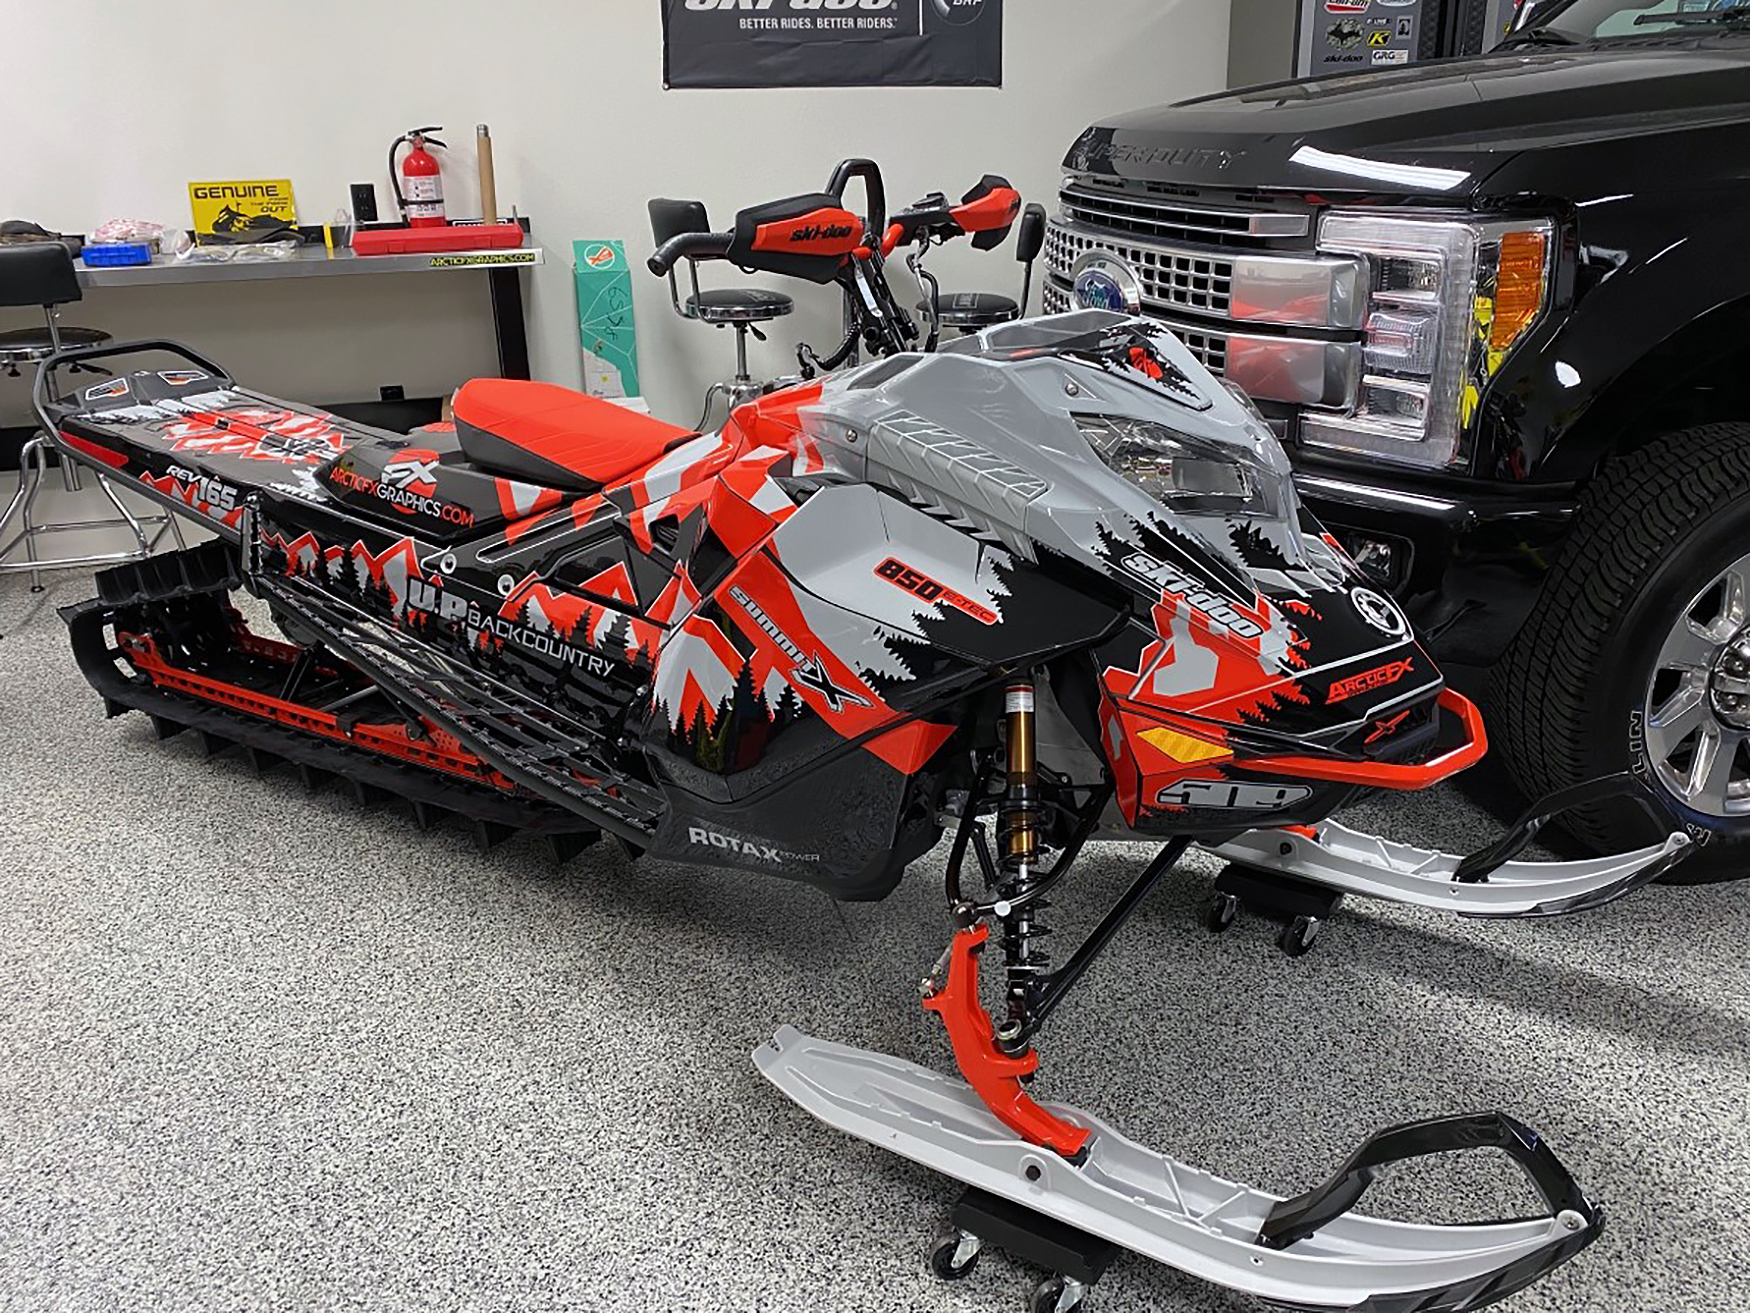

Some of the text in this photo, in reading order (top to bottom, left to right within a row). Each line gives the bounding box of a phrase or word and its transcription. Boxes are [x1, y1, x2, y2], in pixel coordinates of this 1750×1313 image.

[739, 17, 779, 29] BETTER
[781, 17, 814, 29] RIDES.
[817, 17, 854, 29] BETTER
[1372, 51, 1395, 60] GRG
[194, 184, 279, 199] GENUINE
[260, 205, 288, 213] OUT
[789, 225, 852, 243] ski-doo
[166, 465, 238, 511] REV 165
[329, 466, 475, 529] ARCTICFXGRAPHICS.COM
[877, 559, 944, 601] 850
[467, 608, 616, 677] BACKCOUNTRY
[788, 650, 876, 714] X
[688, 827, 782, 863] ROTAX
